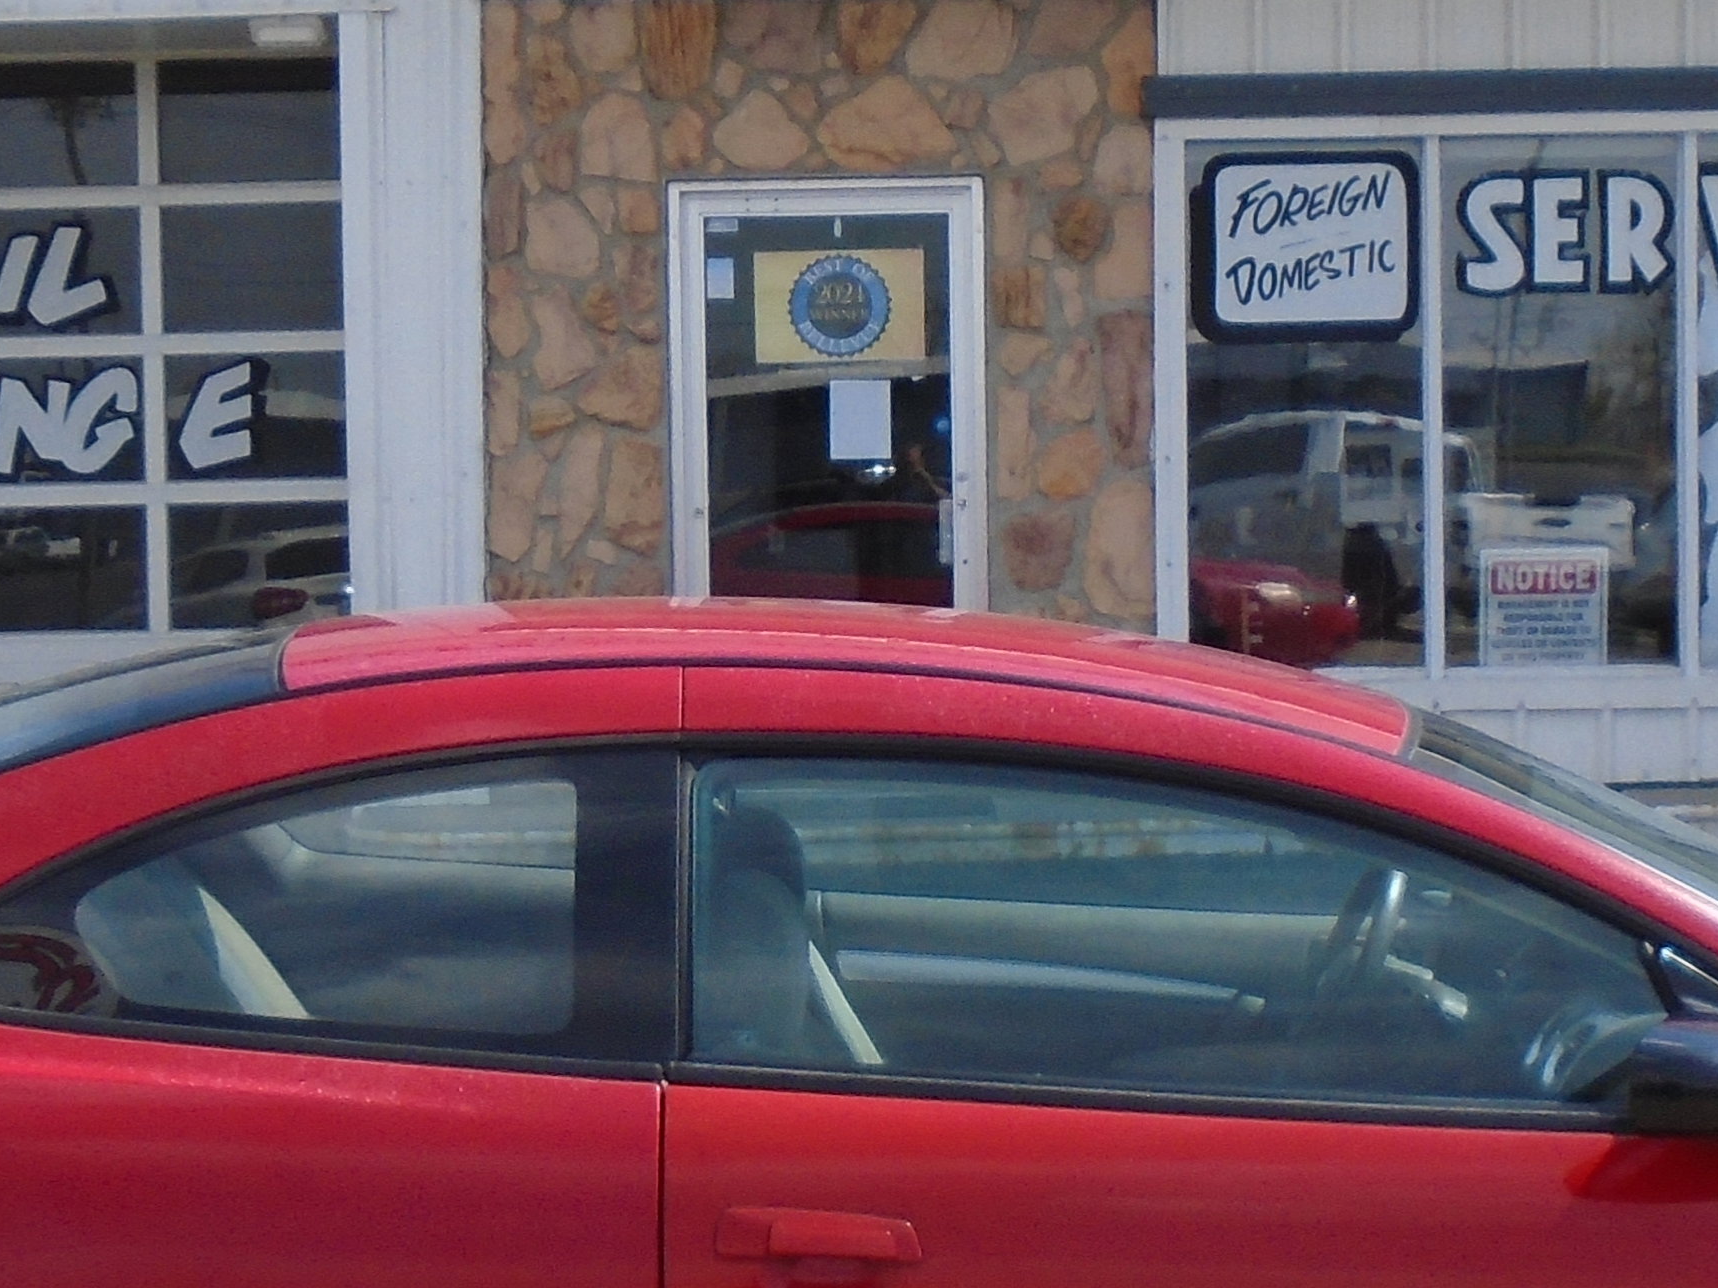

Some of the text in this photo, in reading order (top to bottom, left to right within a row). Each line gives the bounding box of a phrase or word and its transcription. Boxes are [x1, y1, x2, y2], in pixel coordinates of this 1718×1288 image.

[1229, 170, 1392, 239] FOREIGN
[1224, 239, 1396, 306] DOMESTIC
[1497, 564, 1592, 591] NOTICE
